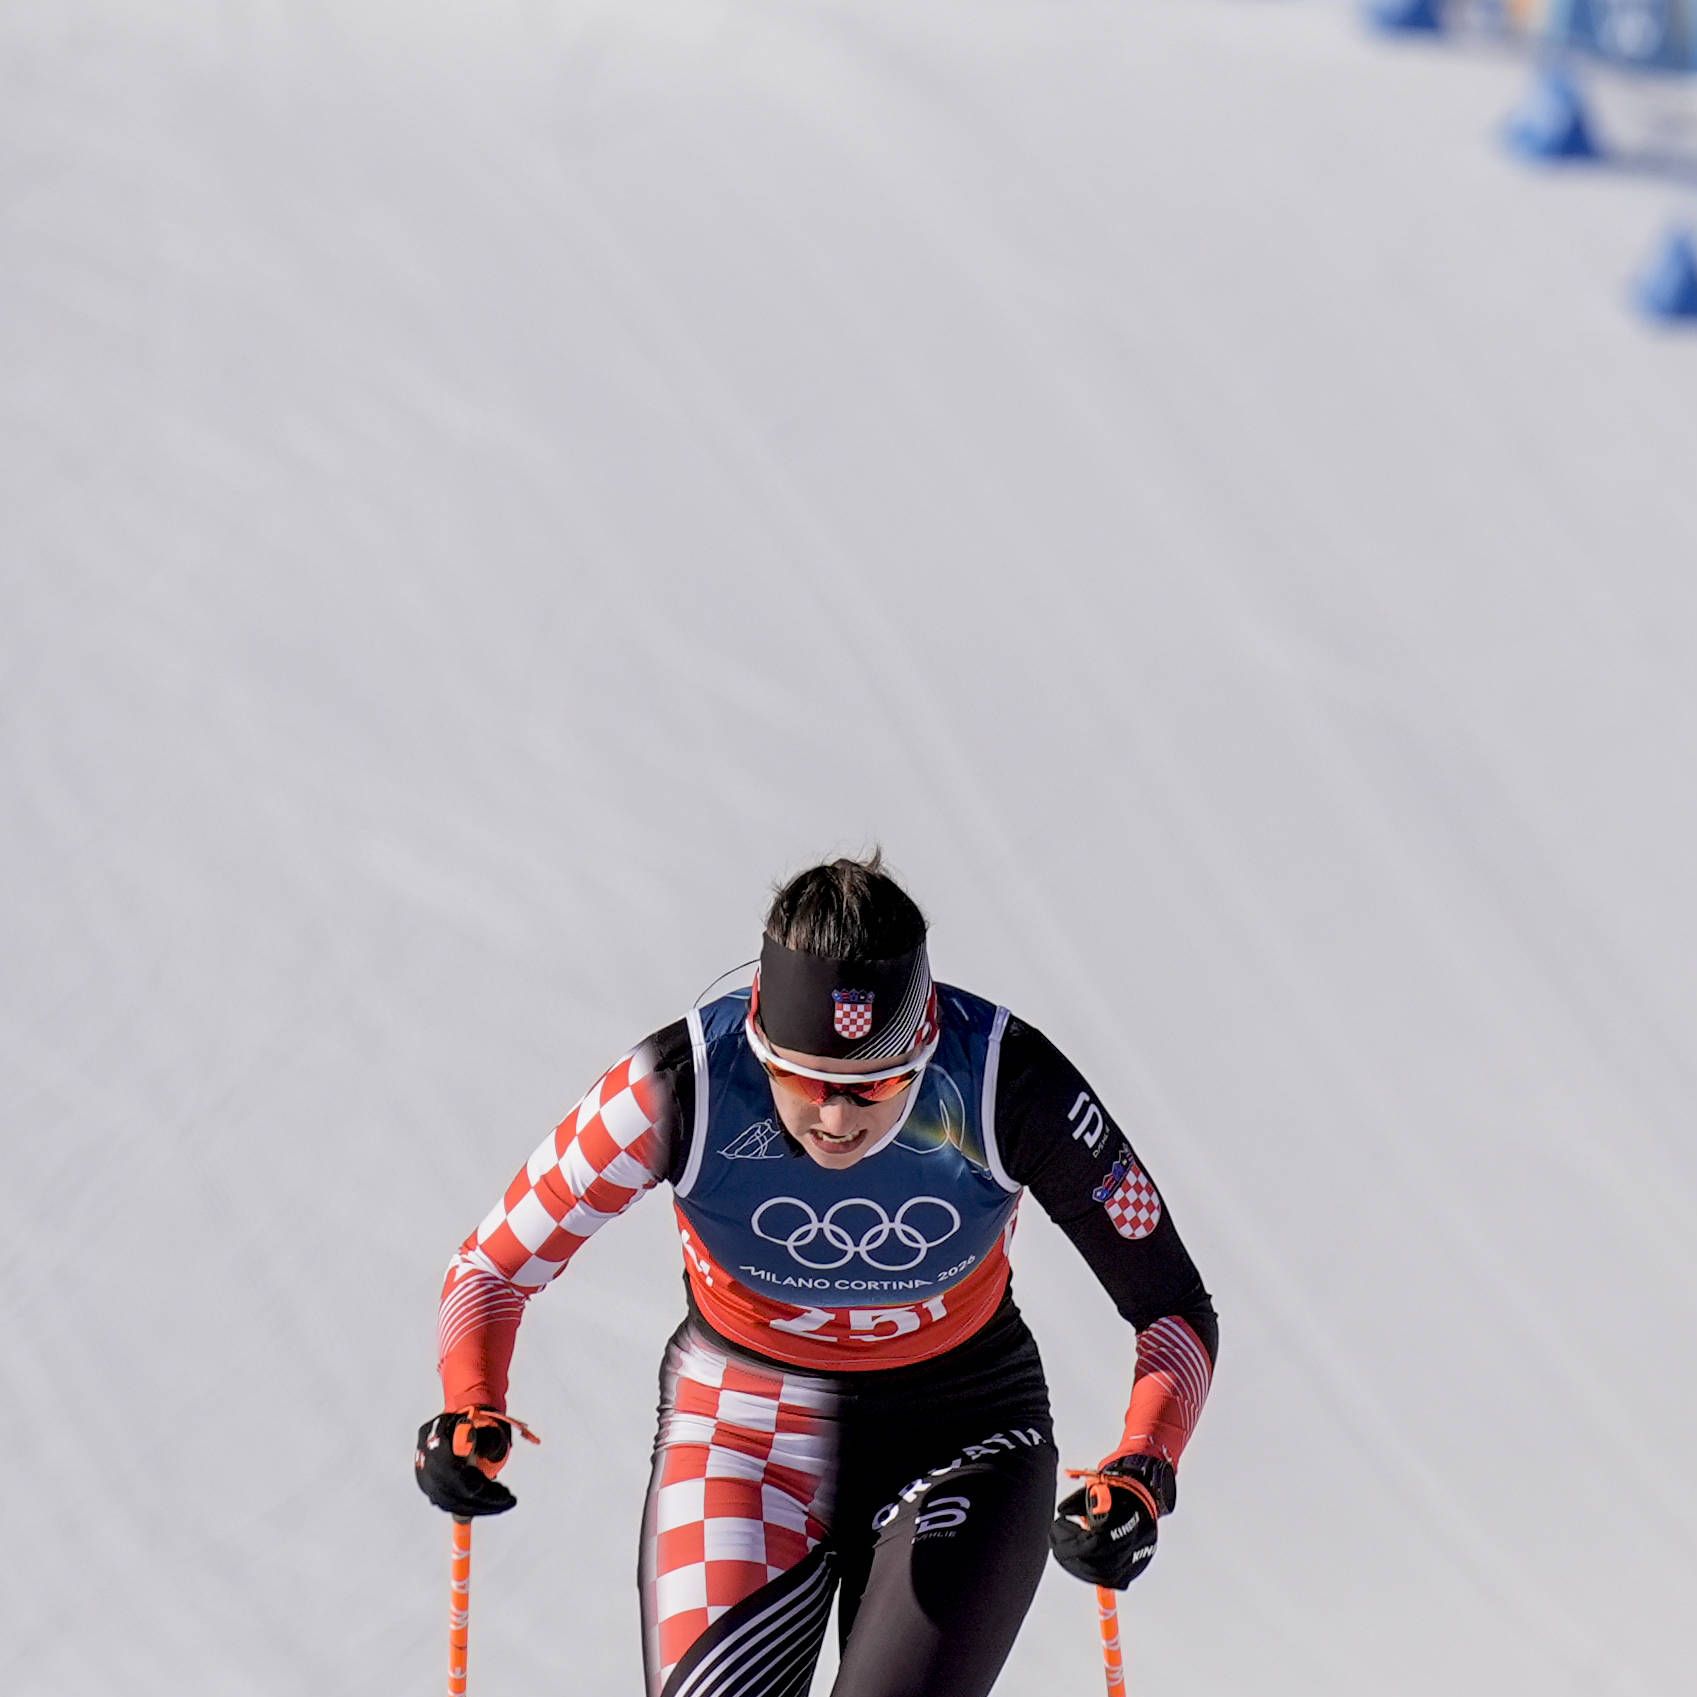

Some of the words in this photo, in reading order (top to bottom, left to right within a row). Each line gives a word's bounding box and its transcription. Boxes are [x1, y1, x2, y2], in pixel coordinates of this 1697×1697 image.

[739, 1265, 830, 1289] MILANO
[834, 1279, 933, 1290] CORTINA
[937, 1255, 976, 1281] 2026
